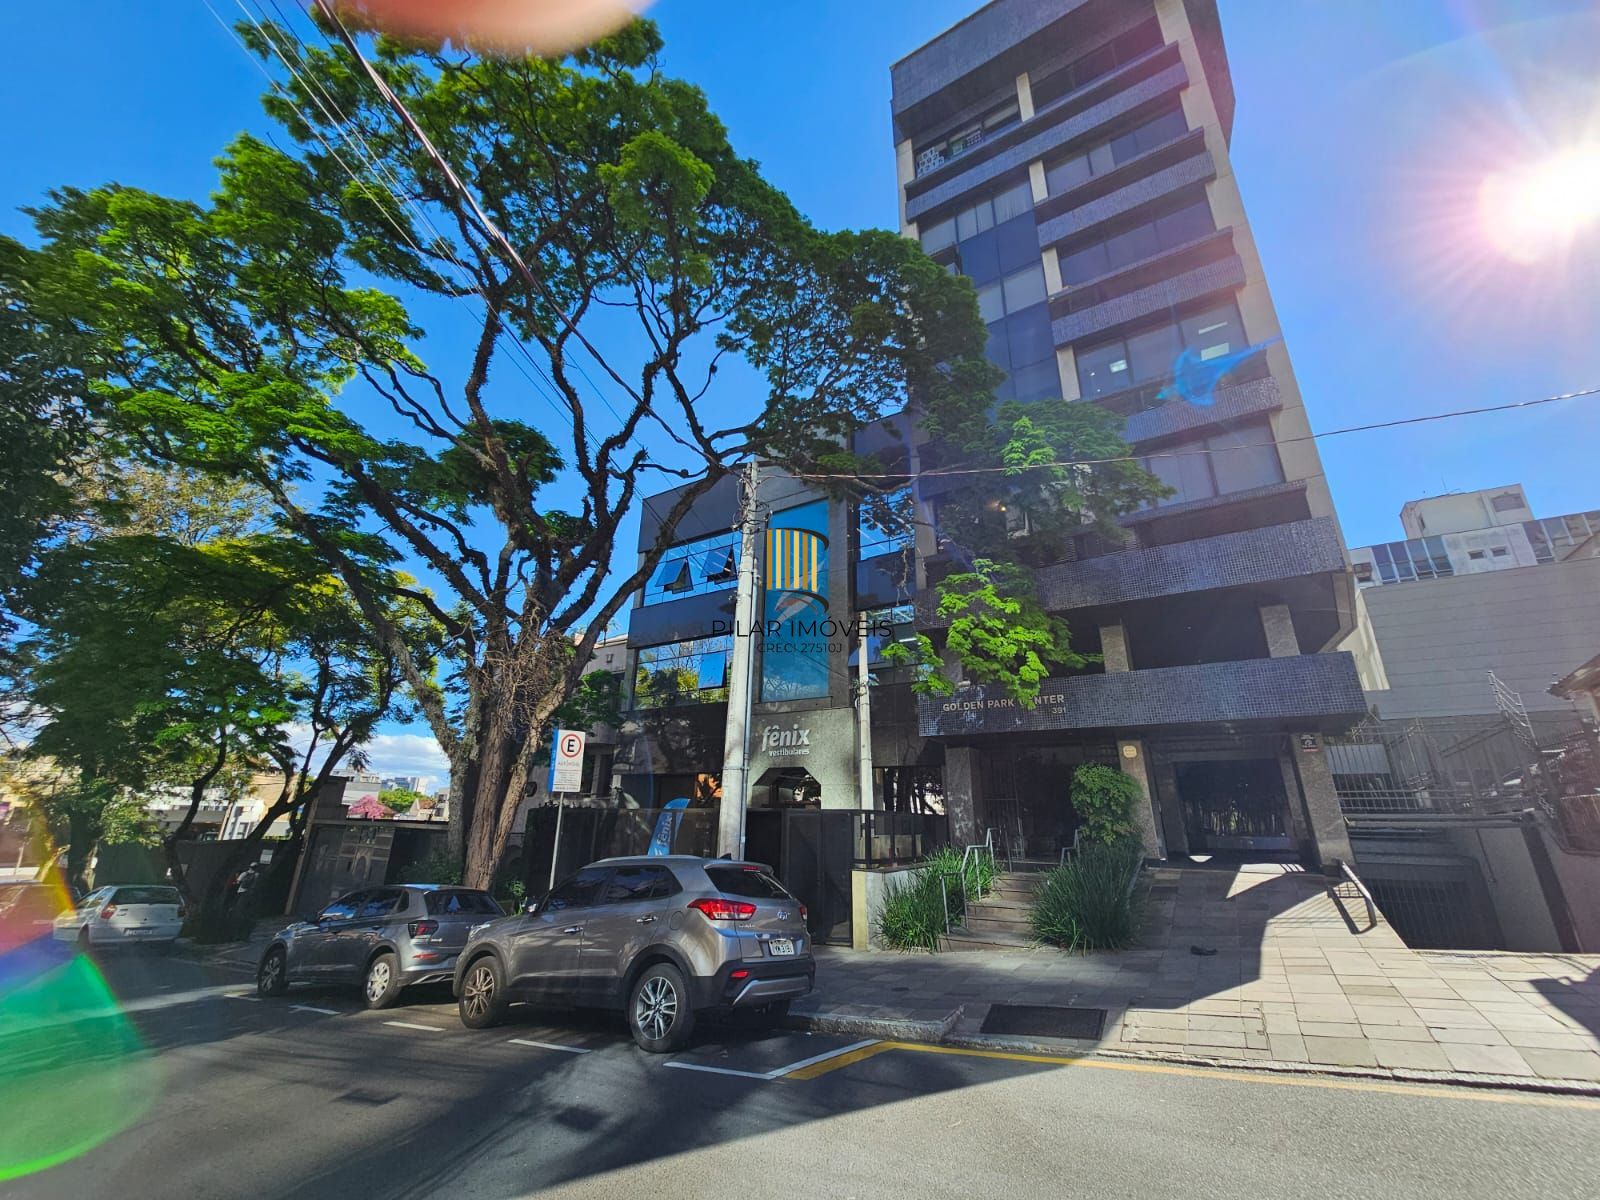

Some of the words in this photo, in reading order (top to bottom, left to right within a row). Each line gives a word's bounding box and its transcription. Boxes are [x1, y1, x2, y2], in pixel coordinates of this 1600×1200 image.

[943, 701, 984, 711] GOLDEN
[987, 698, 1015, 709] PARK
[762, 723, 810, 752] fênix
[567, 738, 576, 752] E
